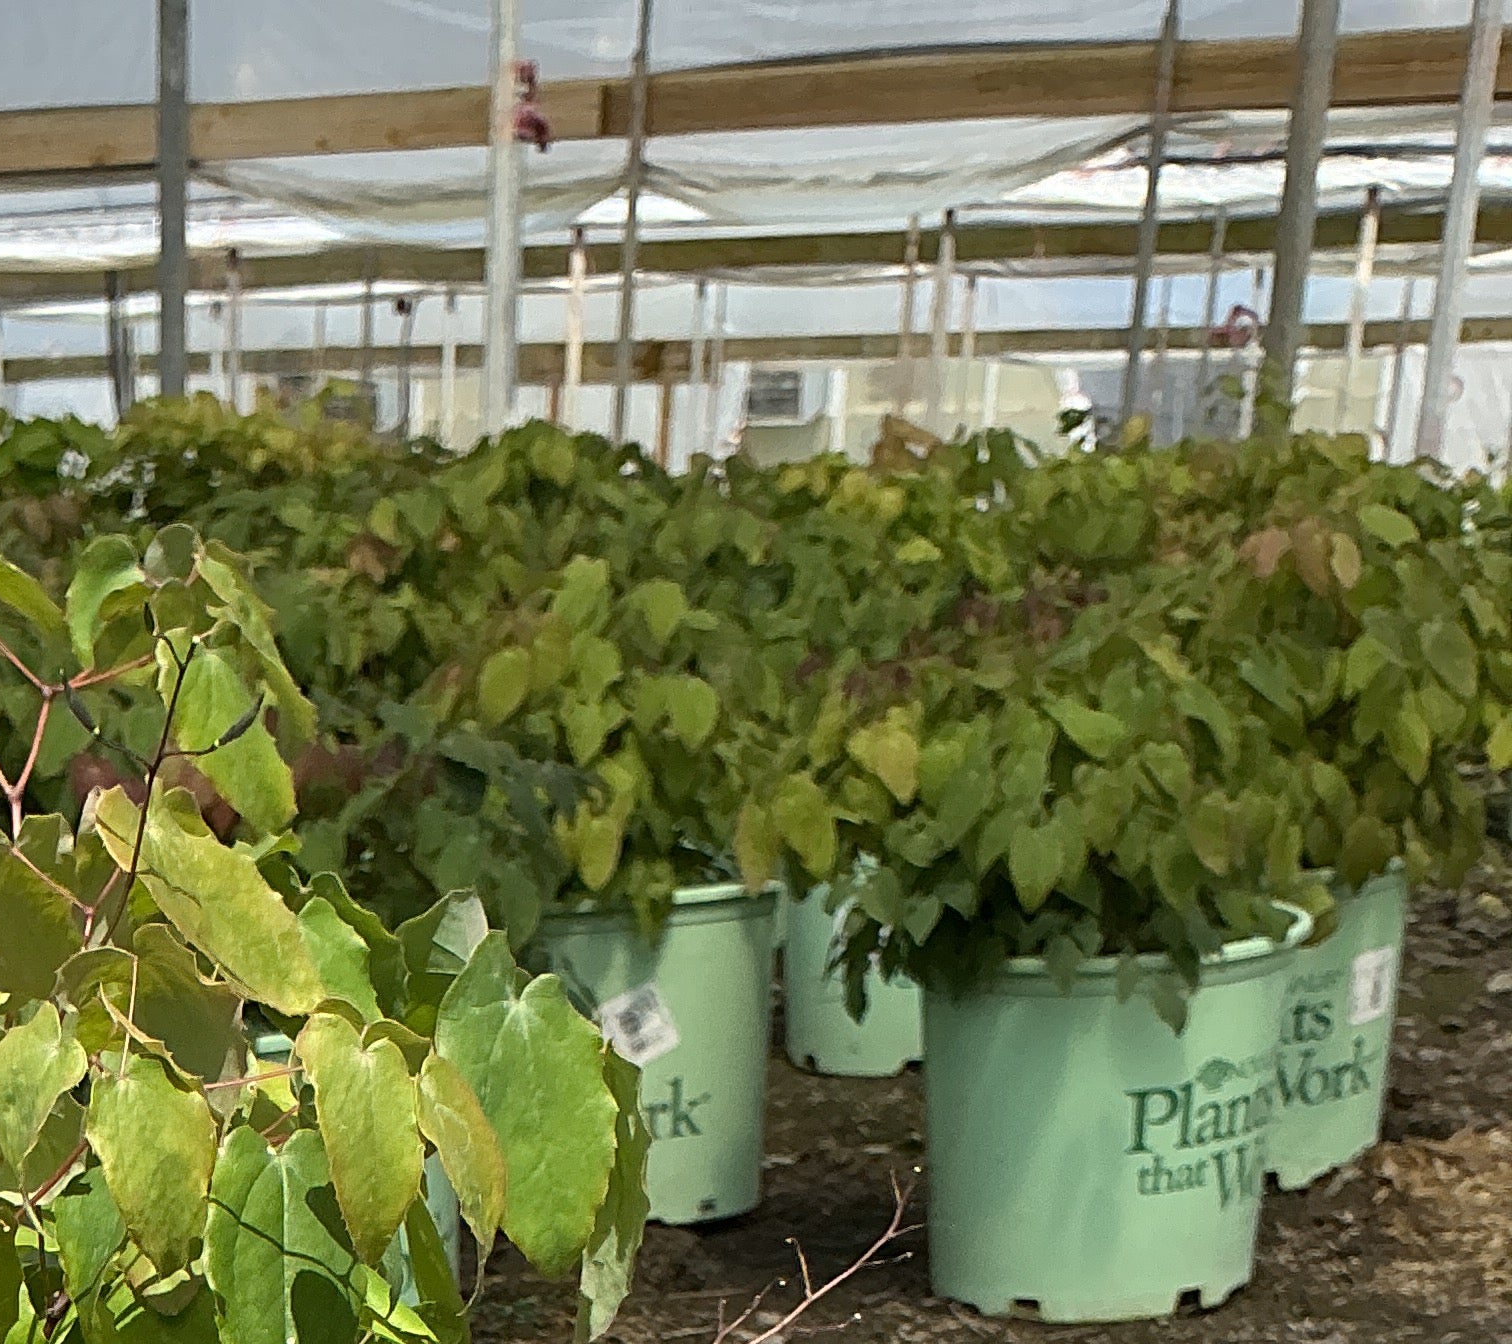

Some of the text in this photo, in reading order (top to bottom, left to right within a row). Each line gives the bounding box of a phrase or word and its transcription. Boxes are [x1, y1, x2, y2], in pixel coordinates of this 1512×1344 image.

[1291, 1000, 1335, 1042] ts
[643, 1076, 711, 1138] rk
[1138, 1154, 1208, 1196] that
